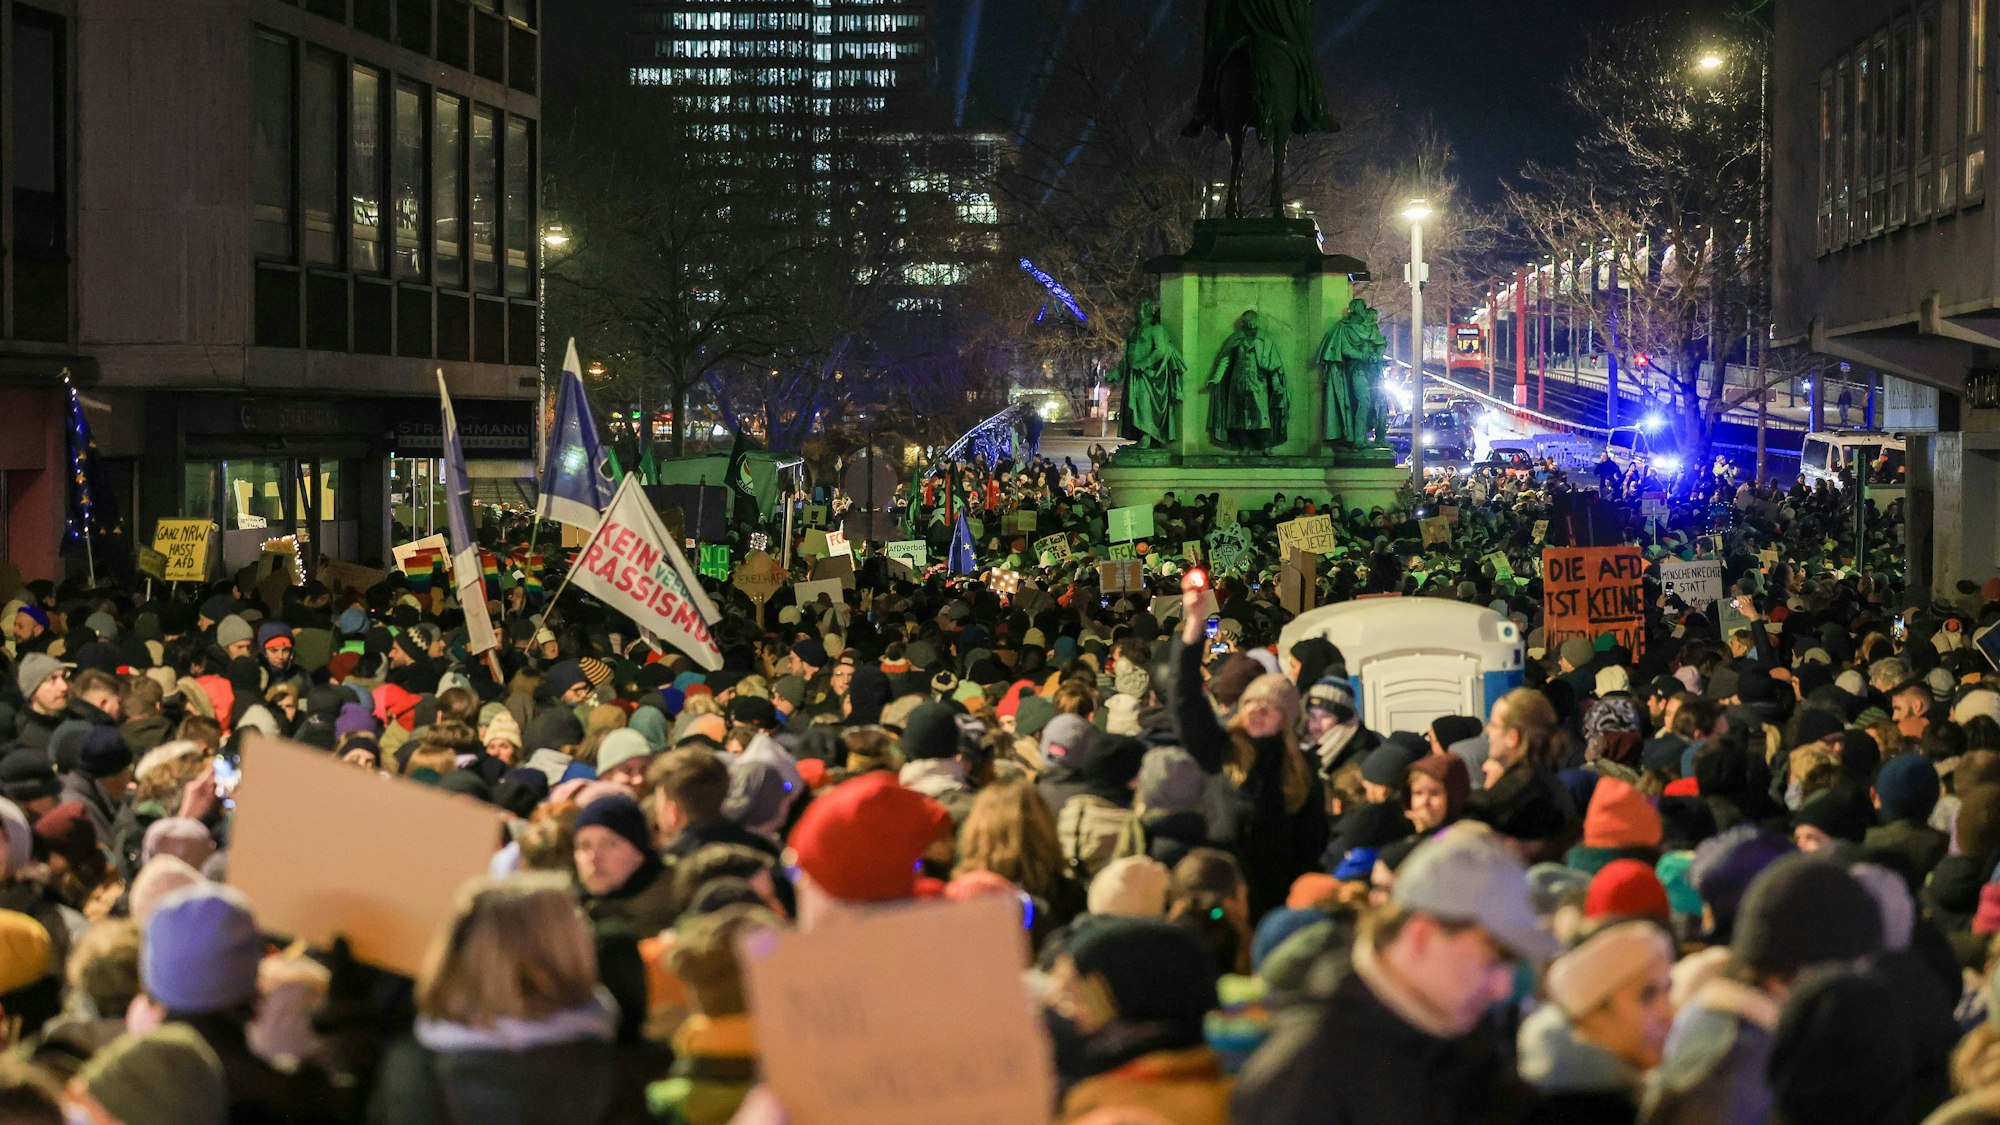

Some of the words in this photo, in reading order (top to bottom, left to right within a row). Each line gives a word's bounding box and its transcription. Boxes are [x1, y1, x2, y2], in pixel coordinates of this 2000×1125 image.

[398, 421, 528, 434] STRAHMANN
[157, 526, 180, 541] GANZ
[180, 525, 209, 542] NRW
[1278, 523, 1297, 540] NIE
[1300, 517, 1331, 537] WIEDER
[597, 519, 661, 573] KEIN
[1305, 534, 1333, 549] JETZT
[169, 543, 195, 557] HASST
[701, 546, 728, 564] NO
[174, 557, 194, 568] AfD
[1549, 556, 1586, 582] DIE
[1599, 554, 1642, 582] AFD
[1661, 566, 1721, 580] MENSCHENRECHTE
[1679, 581, 1706, 593] STATT
[1546, 588, 1580, 617] IST
[1586, 584, 1644, 617] KEINE
